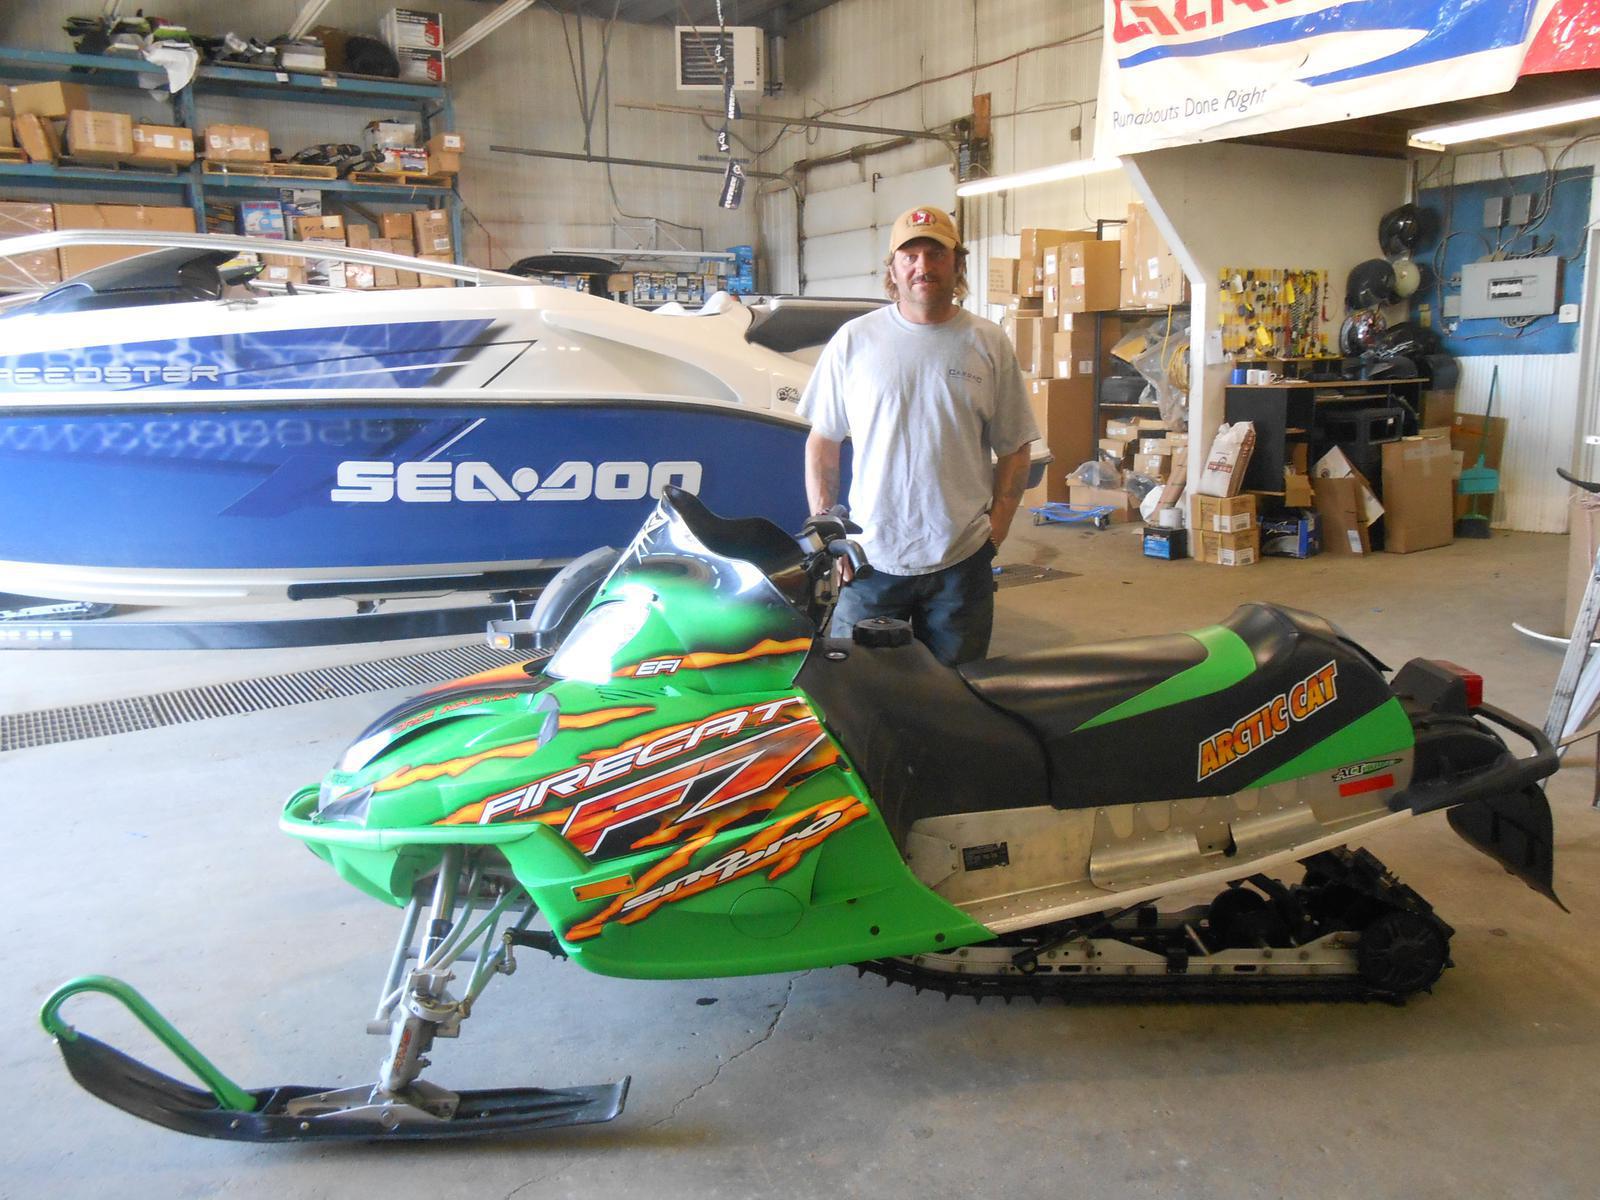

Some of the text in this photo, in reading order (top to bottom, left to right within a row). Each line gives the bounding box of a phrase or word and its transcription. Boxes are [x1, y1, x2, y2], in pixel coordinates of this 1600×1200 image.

[1113, 87, 1267, 130] Runabouts Done Right
[634, 658, 683, 677] EFI
[478, 697, 805, 825] FIRECAT
[1198, 662, 1337, 780] ARCTIC CAT
